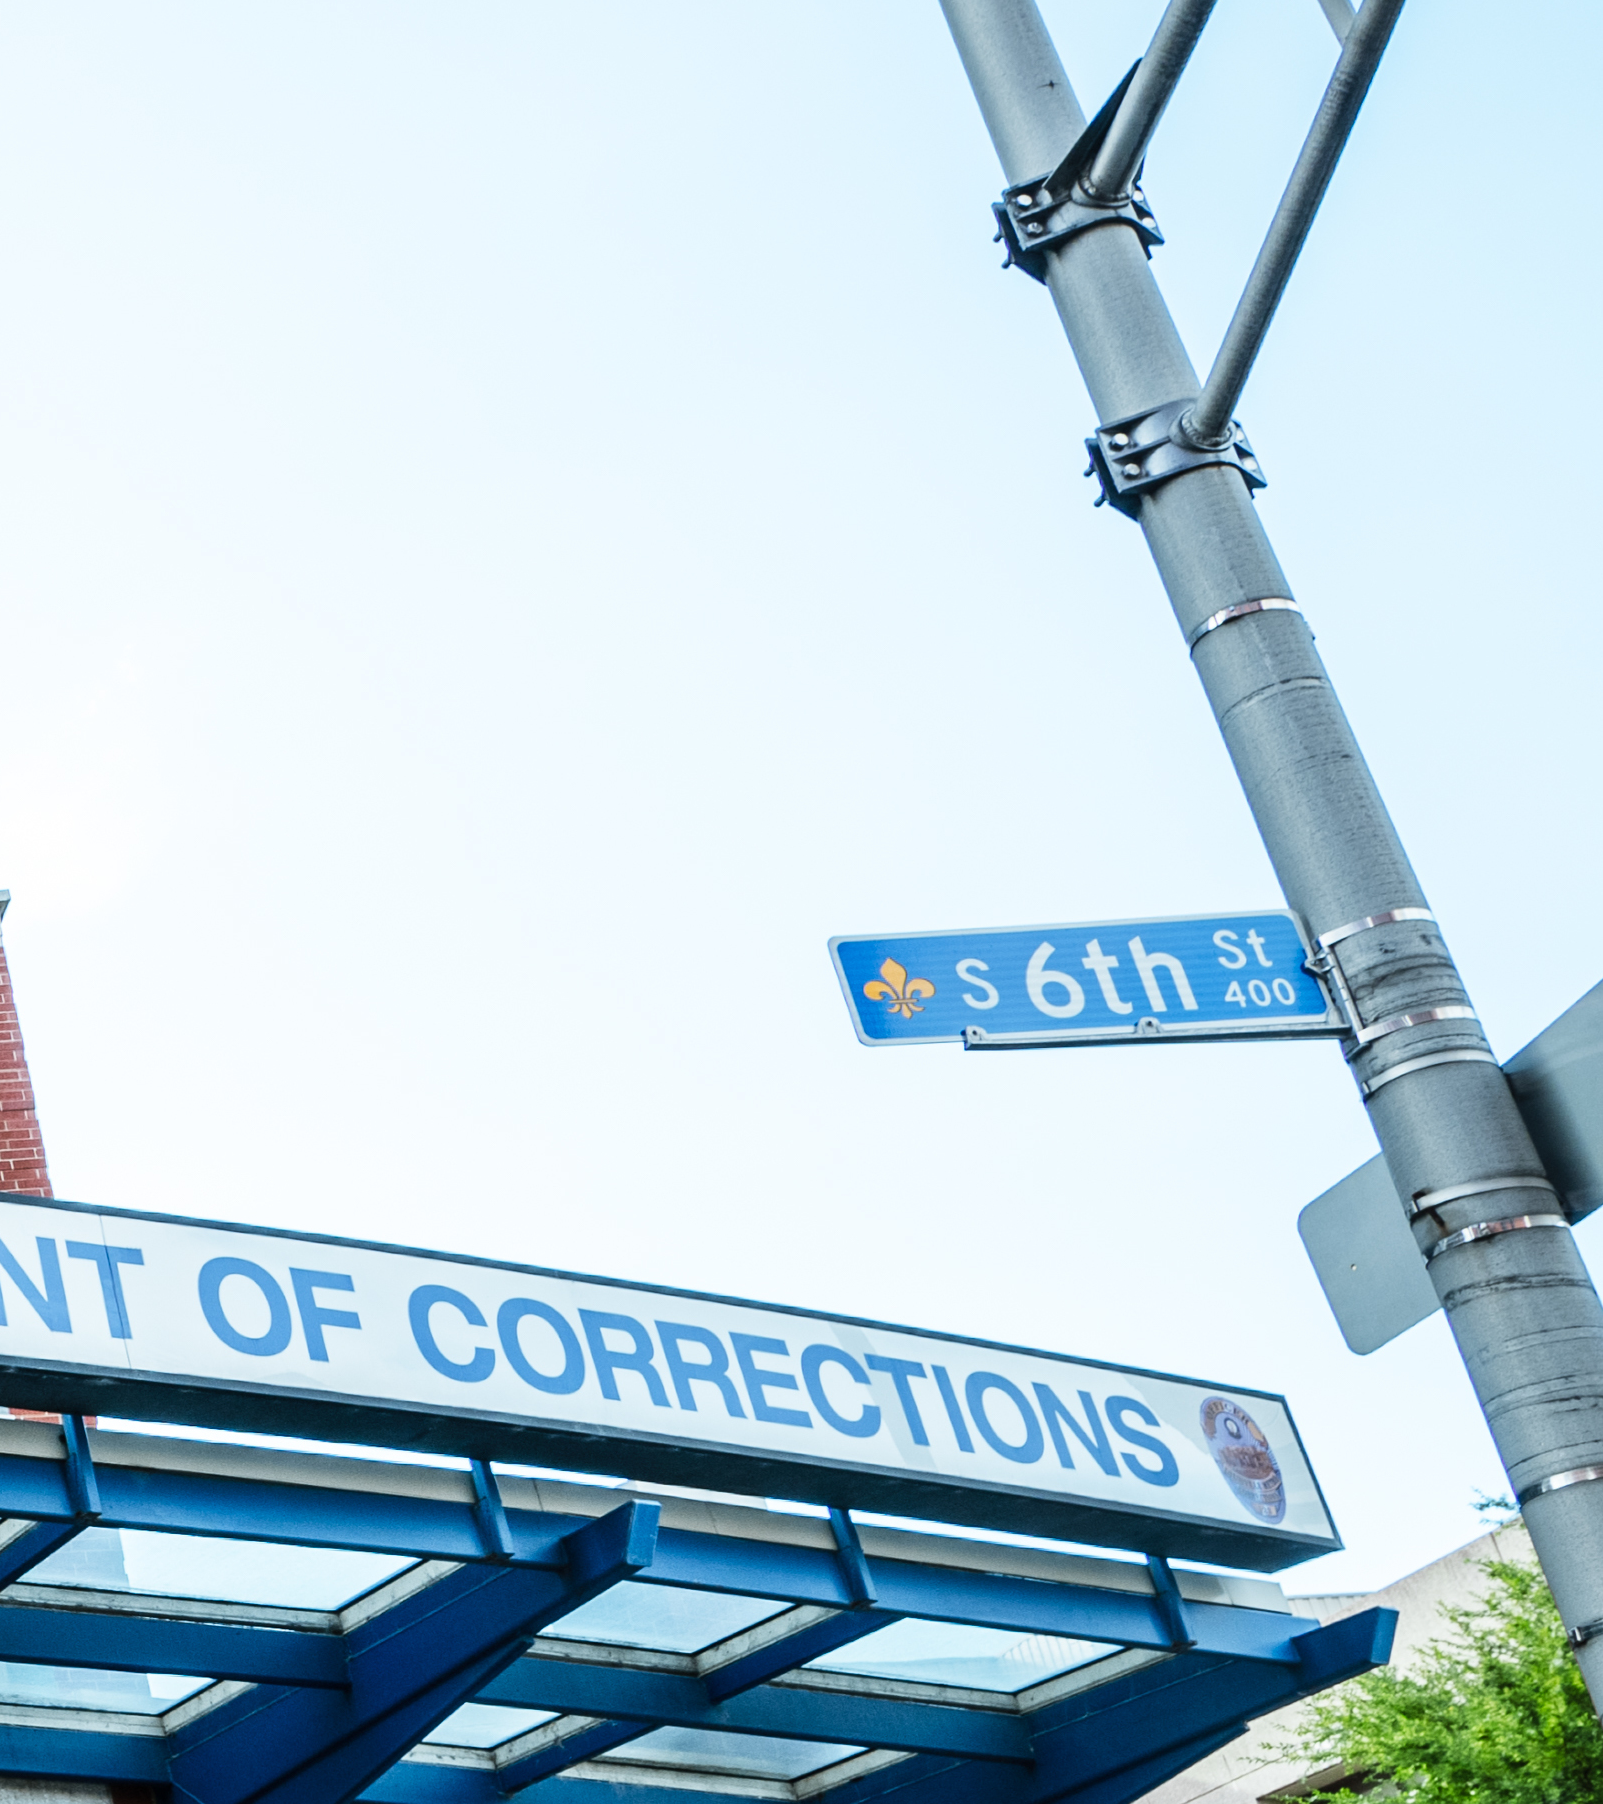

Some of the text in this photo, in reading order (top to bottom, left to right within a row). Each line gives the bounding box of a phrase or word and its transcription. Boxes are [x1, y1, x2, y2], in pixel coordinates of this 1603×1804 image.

[955, 928, 1273, 1019] S 6th St
[1224, 977, 1297, 1009] 400
[197, 1256, 362, 1363] OF
[408, 1283, 1180, 1488] CORRECTIONS
